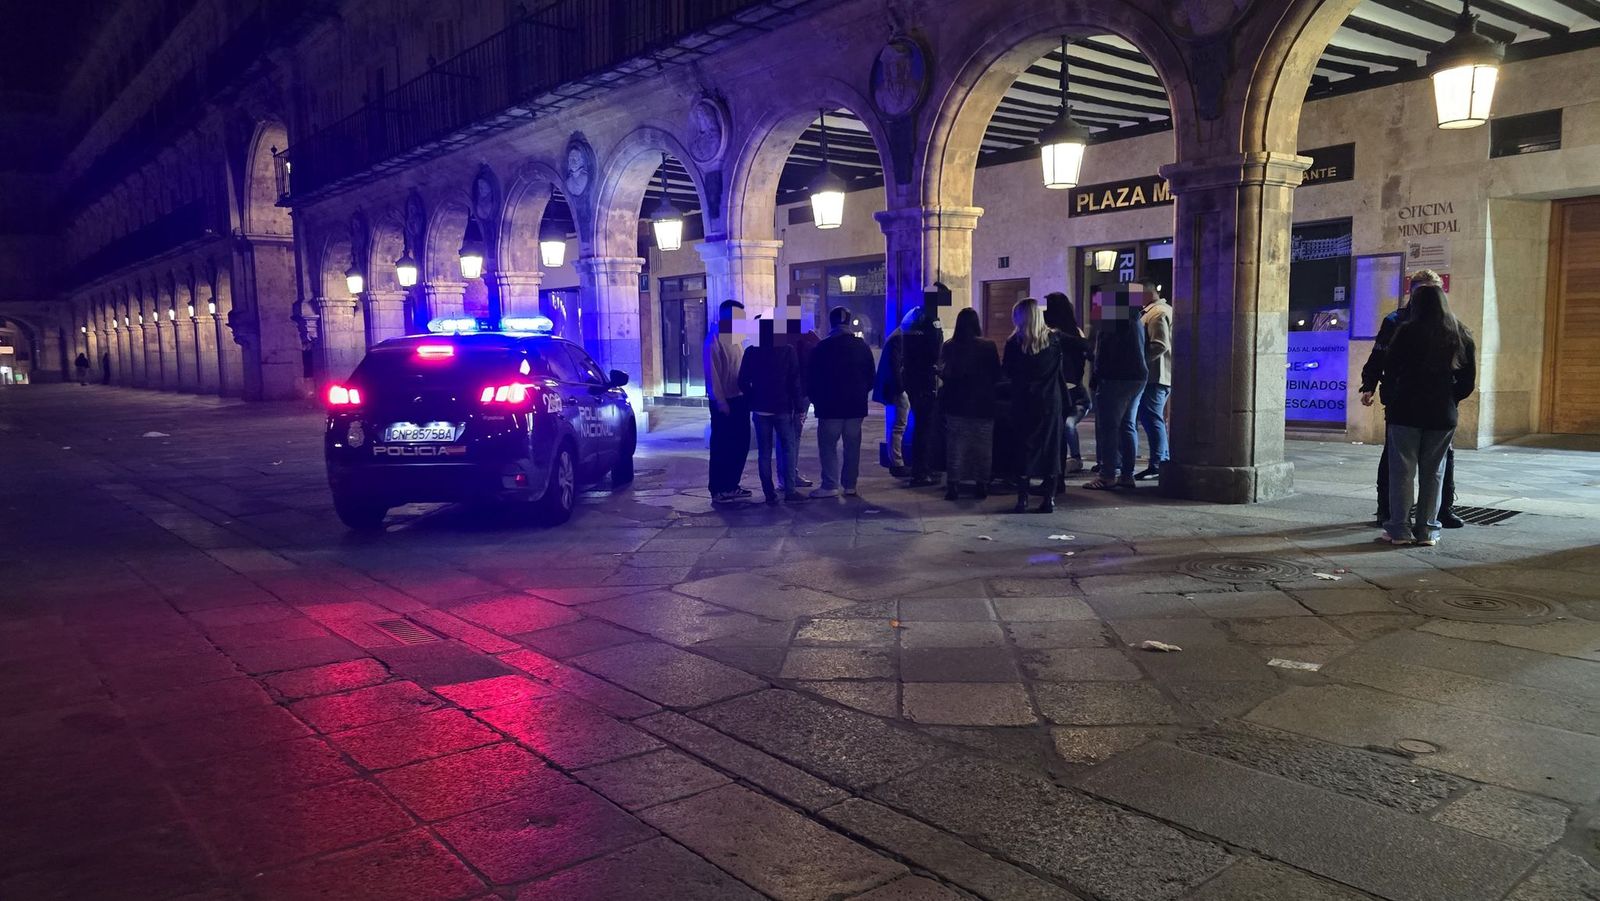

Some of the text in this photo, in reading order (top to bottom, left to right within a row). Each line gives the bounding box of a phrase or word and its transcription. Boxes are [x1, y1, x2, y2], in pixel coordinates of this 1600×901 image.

[1077, 181, 1175, 212] PLAZA M
[1399, 202, 1454, 219] OFICINA
[1398, 219, 1460, 237] MUNICIPAL
[1286, 380, 1347, 391] BINADOS
[373, 446, 450, 456] POLICIA
